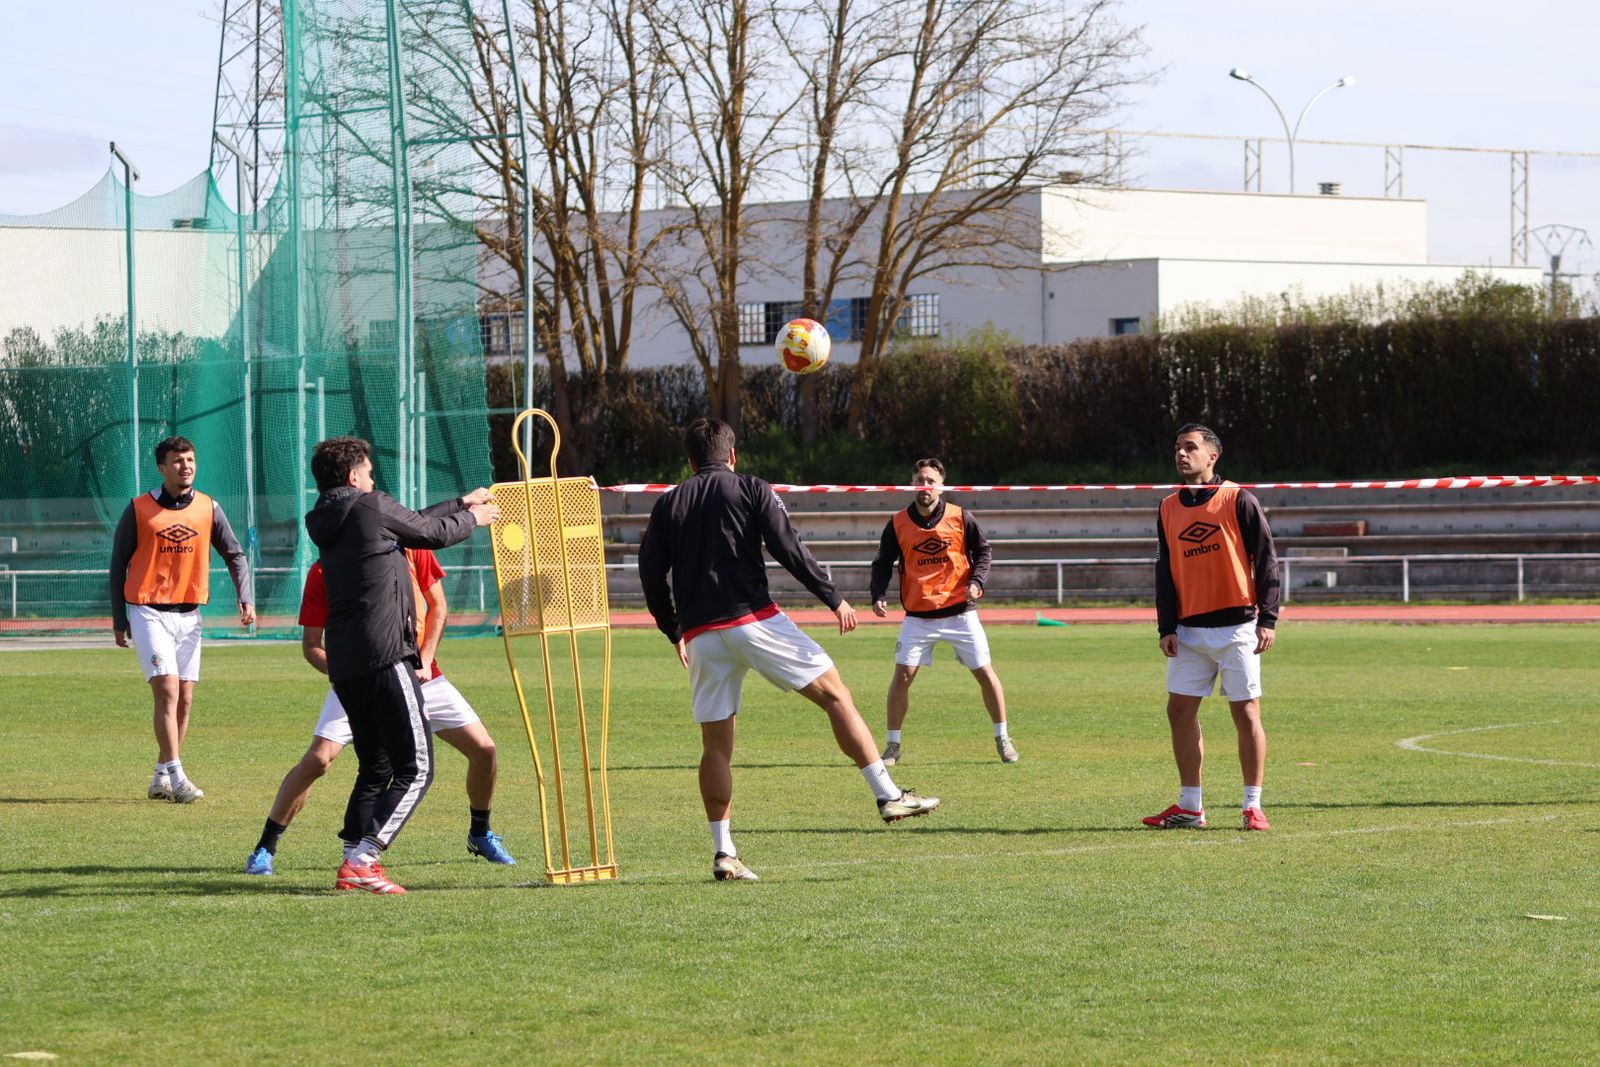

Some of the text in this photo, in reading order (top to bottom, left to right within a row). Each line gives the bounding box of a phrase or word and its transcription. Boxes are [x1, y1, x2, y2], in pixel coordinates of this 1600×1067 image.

[160, 544, 193, 554] umbro
[1184, 543, 1220, 558] umbro
[917, 556, 949, 566] umbro
